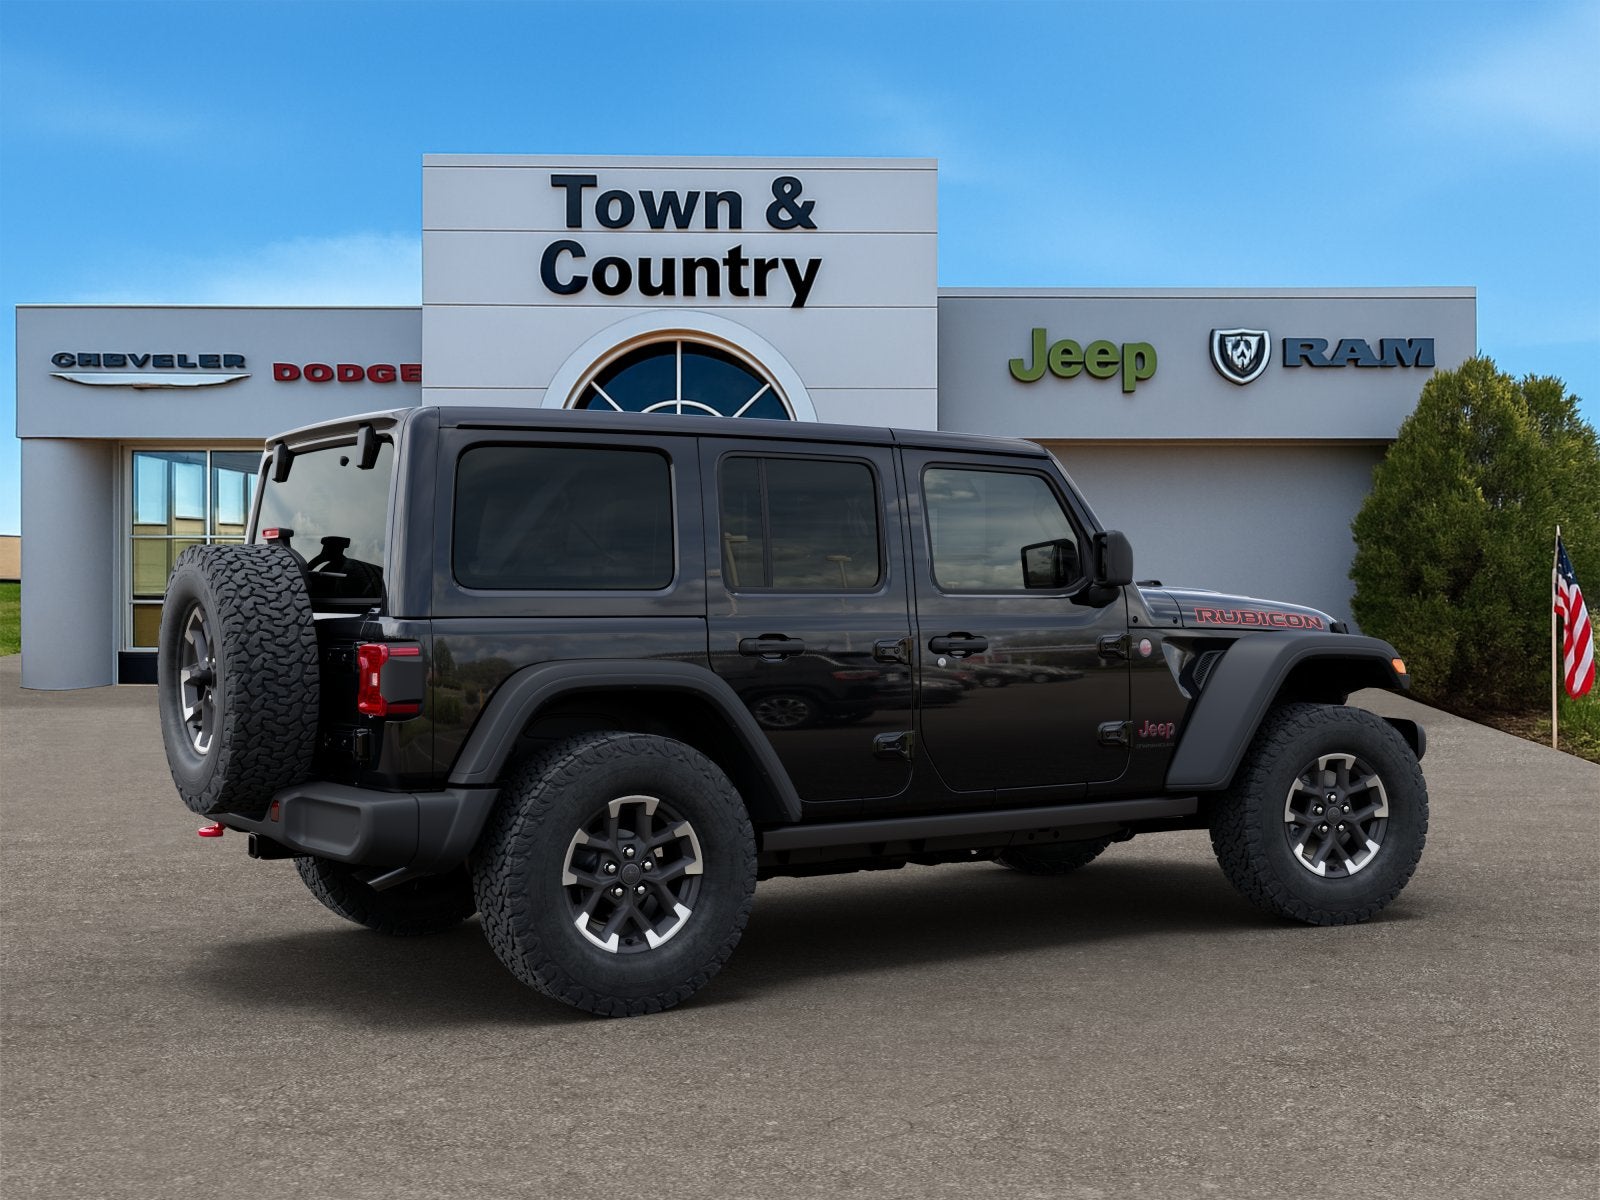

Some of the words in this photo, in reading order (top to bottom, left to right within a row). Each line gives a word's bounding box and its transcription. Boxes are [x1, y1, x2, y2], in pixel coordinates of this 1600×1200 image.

[550, 174, 743, 229] Town
[765, 175, 818, 230] &
[540, 239, 822, 308] Country
[1008, 327, 1157, 393] Jeep
[1283, 338, 1436, 368] RAM
[273, 363, 422, 383] DODGE
[1194, 607, 1324, 630] RUBICON
[1138, 720, 1176, 739] Jeep
